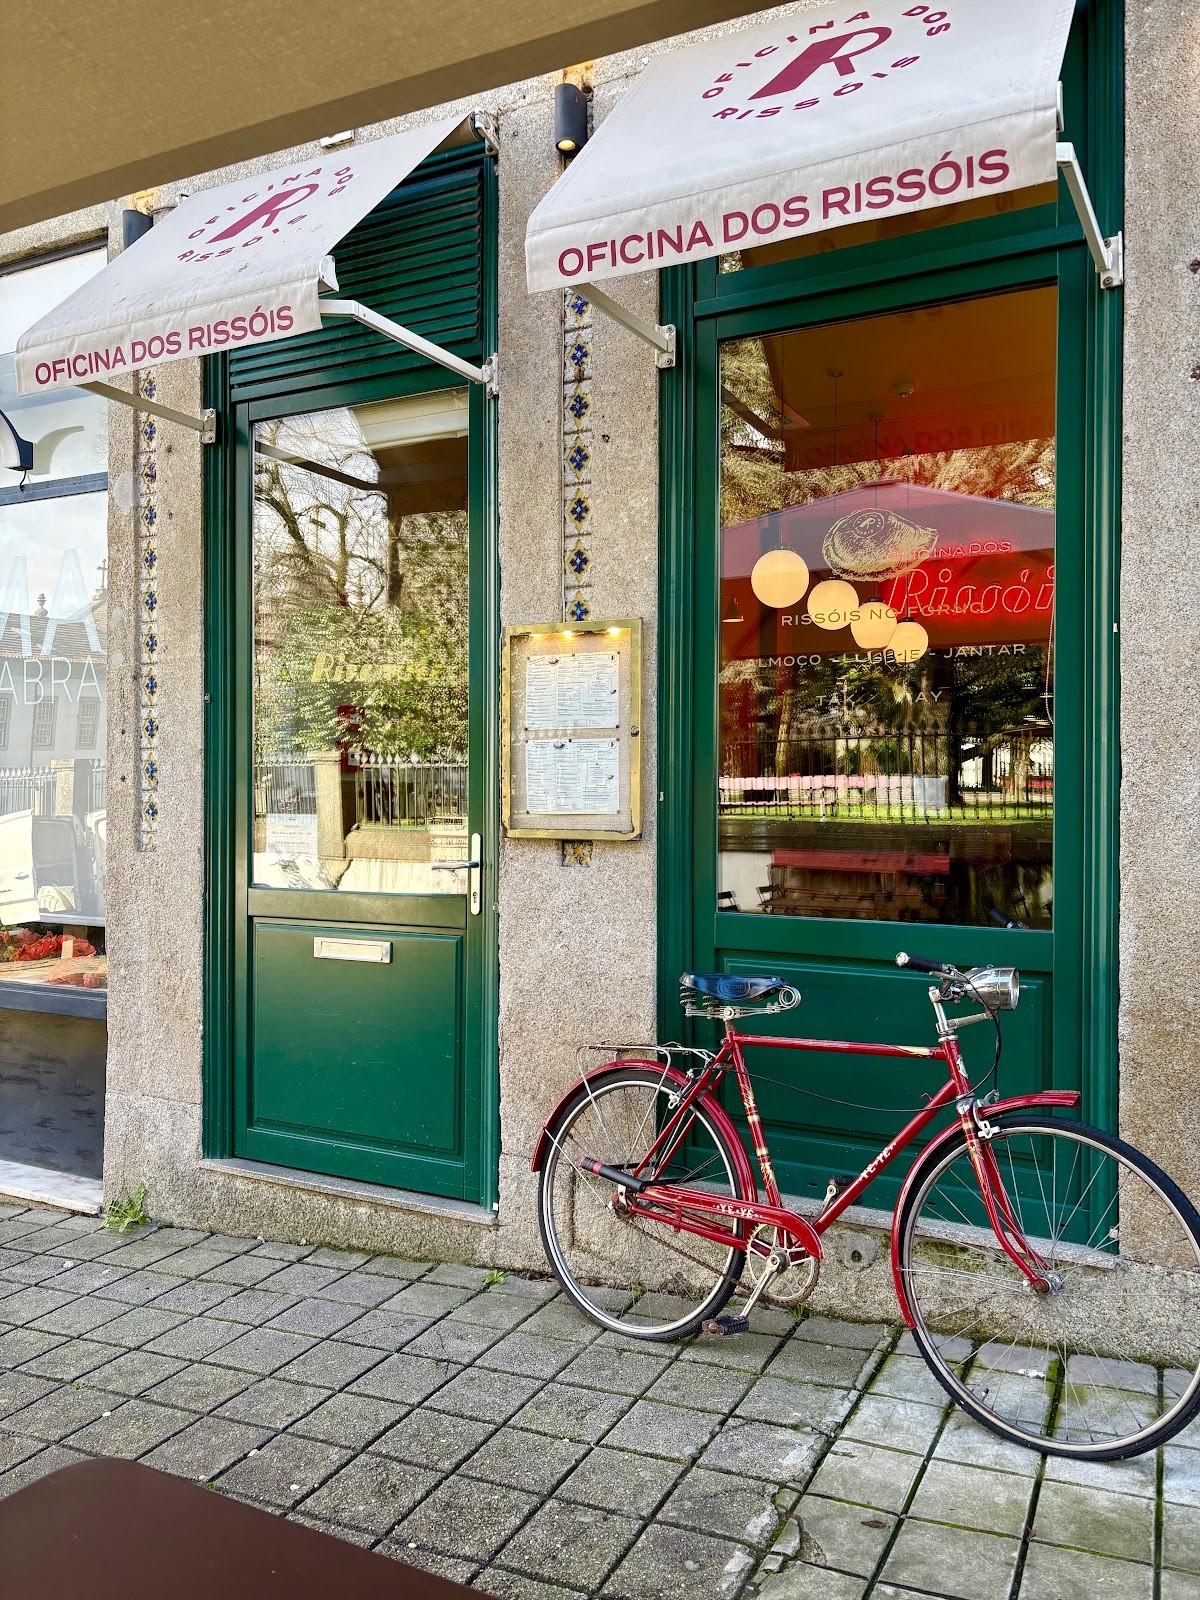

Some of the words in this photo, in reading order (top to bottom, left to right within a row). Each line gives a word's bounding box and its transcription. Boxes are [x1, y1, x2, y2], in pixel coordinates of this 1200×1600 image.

[702, 11, 870, 99] OFICINA
[902, 5, 951, 37] DOS
[328, 166, 354, 197] DOS
[558, 220, 714, 277] OFICINA
[723, 196, 810, 243] DOS
[823, 149, 1010, 220] RISSÓIS
[35, 346, 127, 385] OFICINA
[131, 331, 182, 364] DOS
[188, 305, 294, 349] RISSÓIS
[969, 541, 1012, 554] DOS
[781, 608, 861, 627] RISSÓIS
[869, 608, 898, 620] NO
[943, 643, 1026, 659] JANTAR
